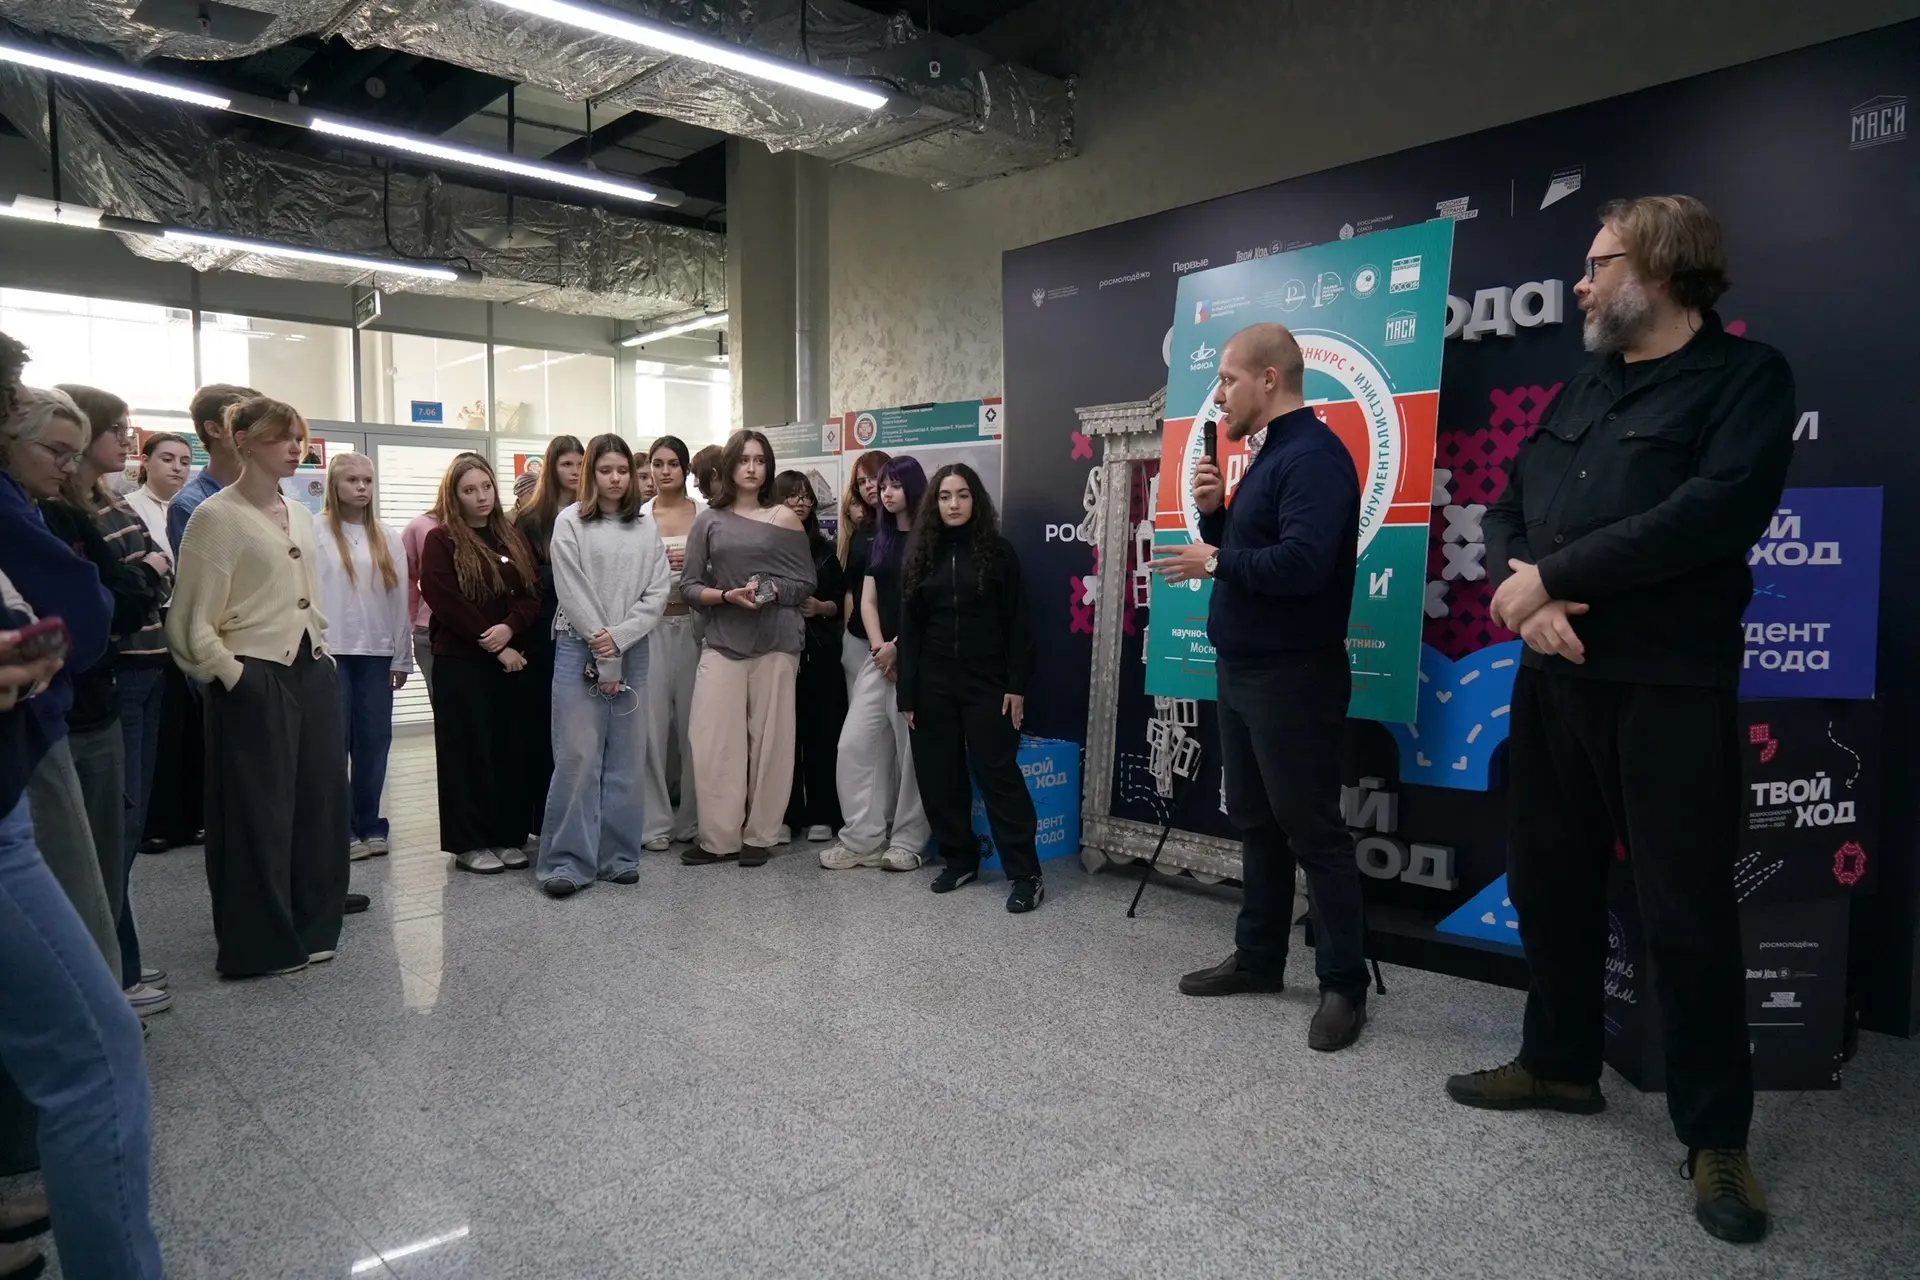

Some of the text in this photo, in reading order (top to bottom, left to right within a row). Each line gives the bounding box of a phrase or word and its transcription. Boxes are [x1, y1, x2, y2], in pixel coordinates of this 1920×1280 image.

[1851, 105, 1905, 142] МАСИ
[1172, 258, 1209, 274] Первые
[1444, 278, 1564, 342] ода
[1385, 318, 1416, 341] МАСИ
[418, 407, 437, 417] 7.06
[1748, 541, 1842, 565] ХОД
[1343, 638, 1386, 651] утник»
[1741, 622, 1831, 645] дент
[1190, 641, 1217, 655] Моск
[1743, 649, 1830, 672] года
[1019, 757, 1054, 778] ВОЙ
[1035, 771, 1068, 790] ХОД
[1750, 771, 1832, 807] ТВОЙ
[1036, 814, 1065, 833] дент
[1794, 800, 1857, 829] ХОД
[1034, 828, 1065, 846] года
[1354, 836, 1460, 891] ОД
